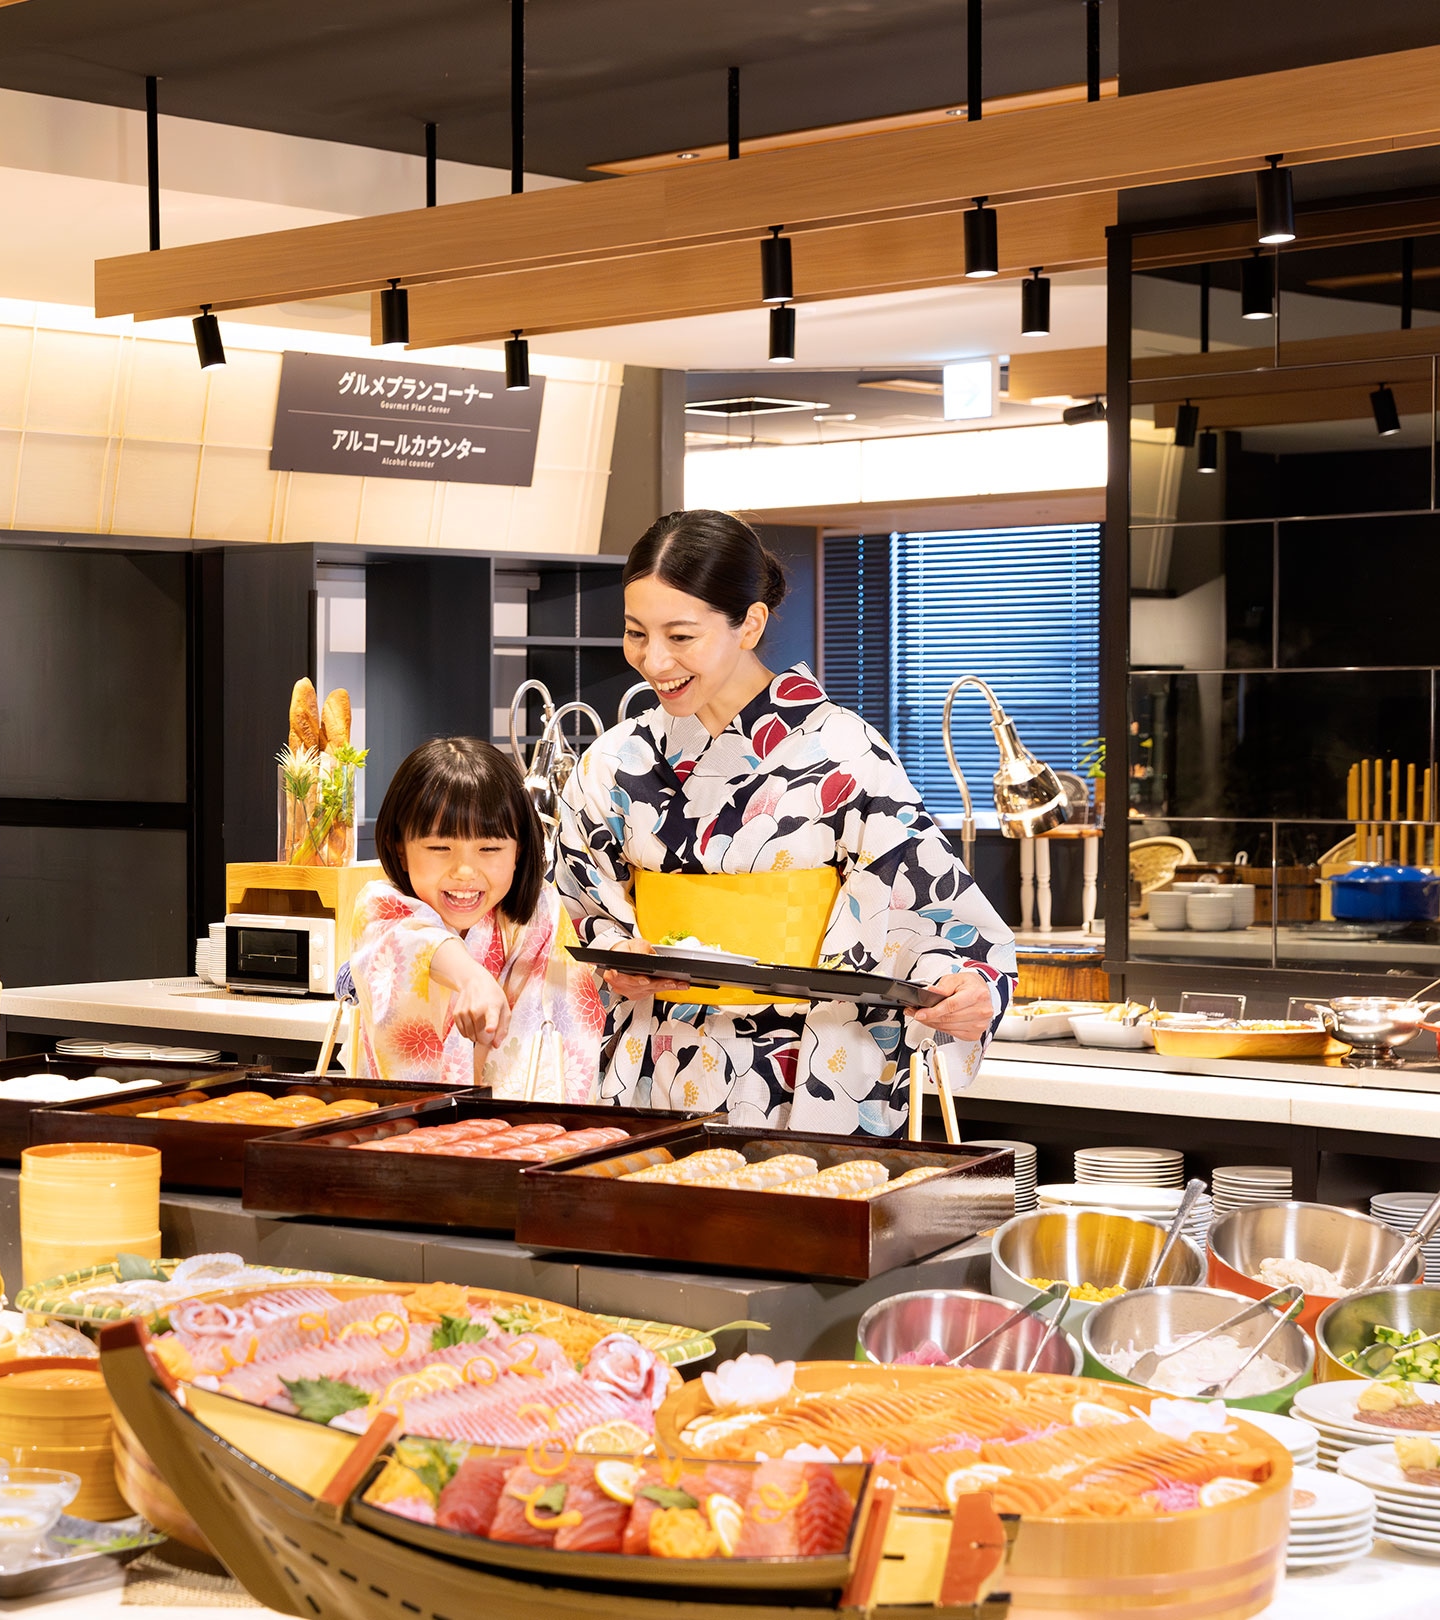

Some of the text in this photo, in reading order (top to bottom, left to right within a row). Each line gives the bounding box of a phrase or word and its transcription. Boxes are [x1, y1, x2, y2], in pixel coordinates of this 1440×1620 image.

[338, 371, 494, 405] グルメプランコーナー
[380, 400, 451, 415] Gourmet Plan Corner
[332, 429, 486, 460] アルコールカウンター
[381, 457, 435, 469] Alcohol counter
